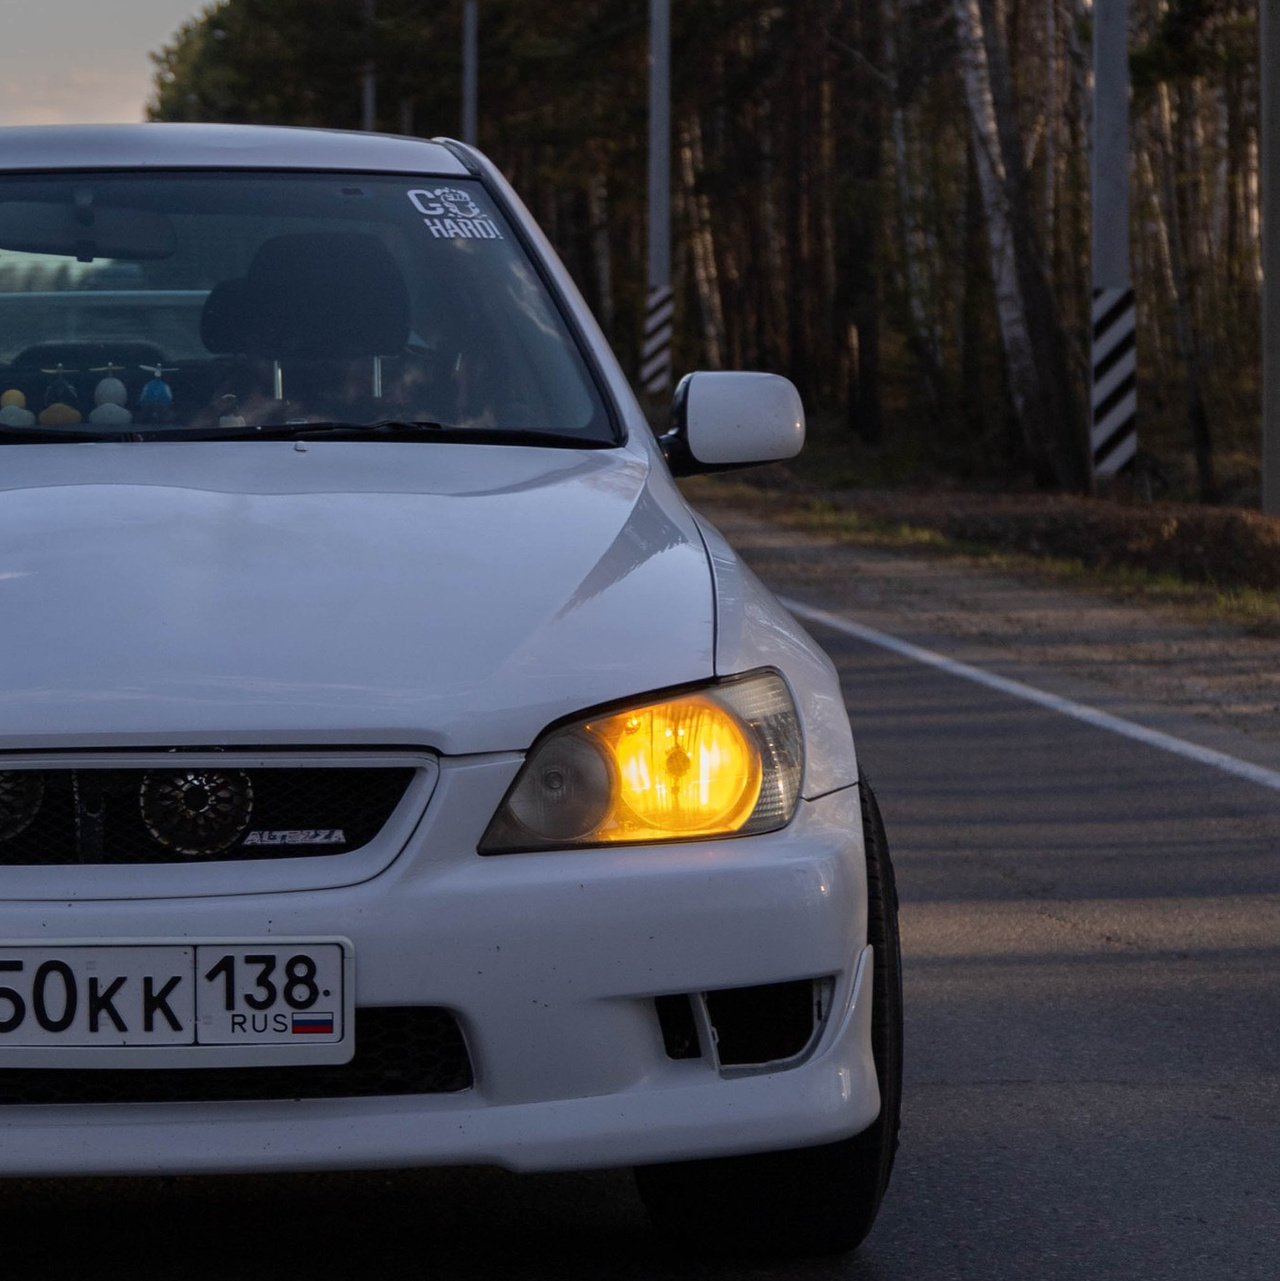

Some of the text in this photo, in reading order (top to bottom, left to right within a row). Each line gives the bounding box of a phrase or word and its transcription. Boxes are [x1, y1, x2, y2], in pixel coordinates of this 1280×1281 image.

[424, 218, 504, 240] HARD!
[243, 829, 346, 845] ALTEZZA
[205, 954, 319, 1011] 138
[231, 1014, 288, 1033] RUS
